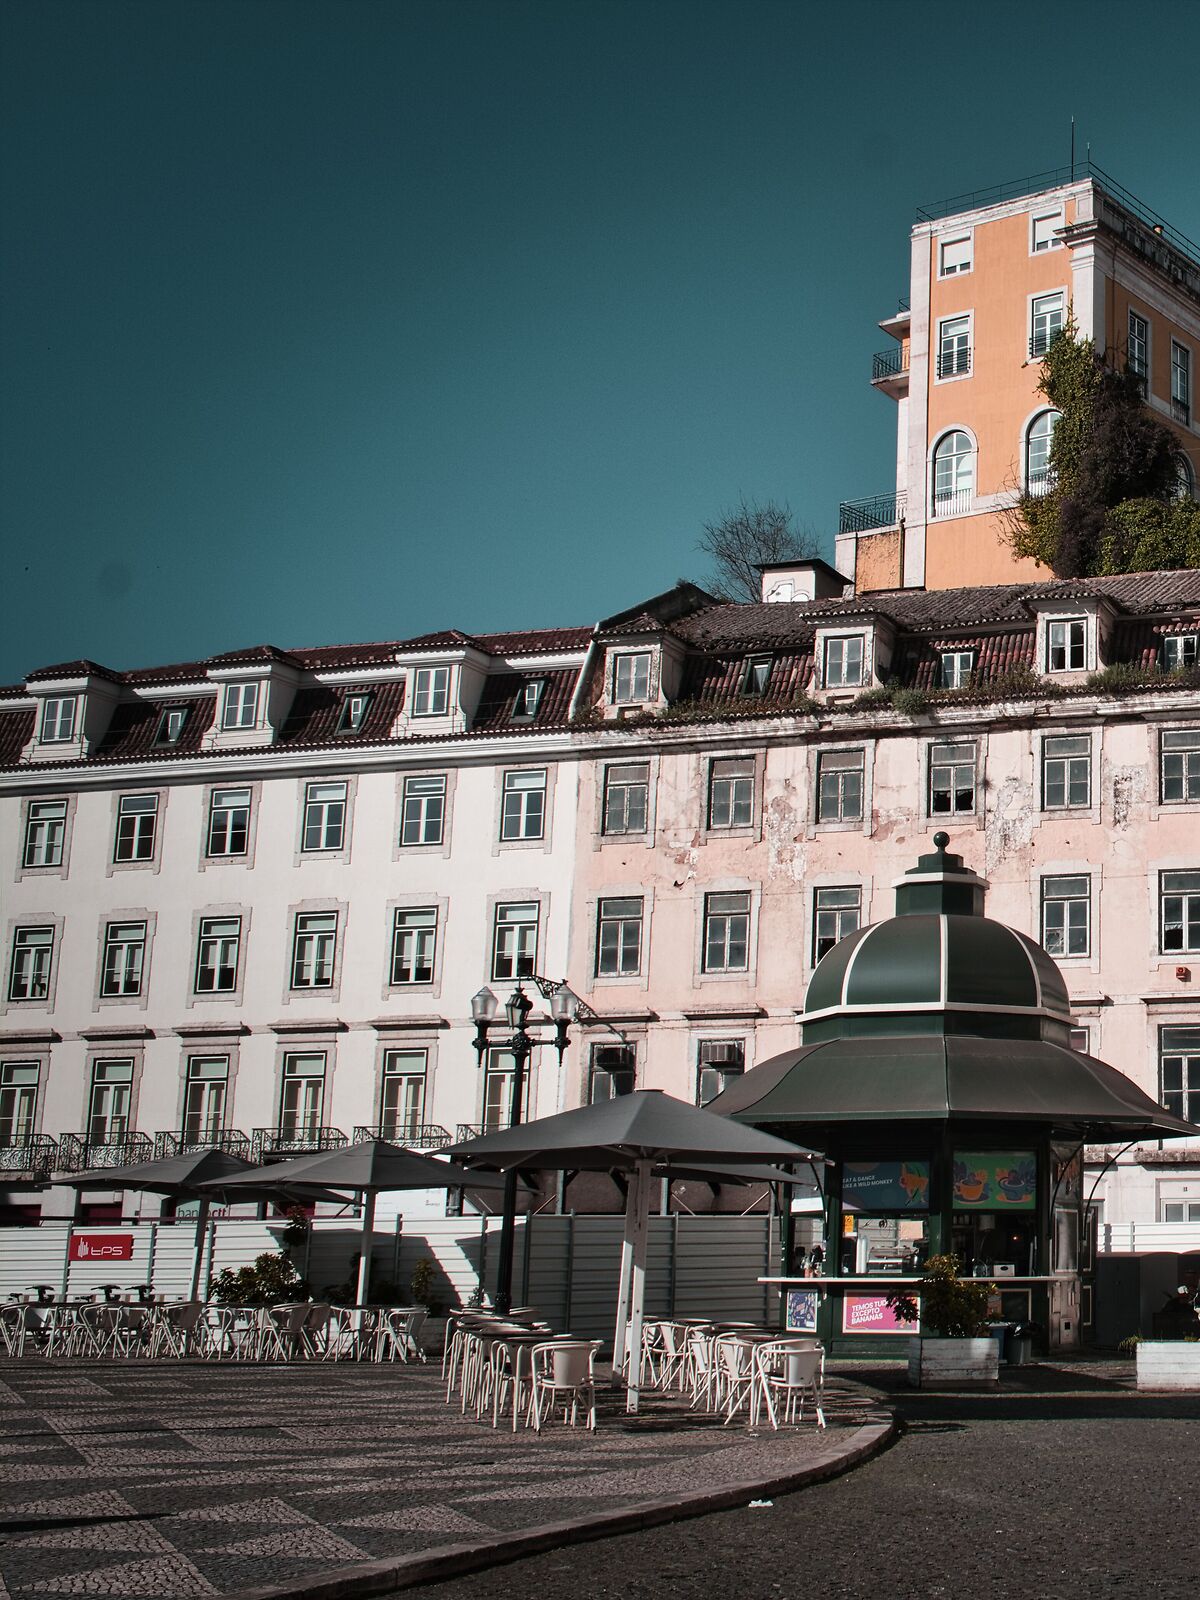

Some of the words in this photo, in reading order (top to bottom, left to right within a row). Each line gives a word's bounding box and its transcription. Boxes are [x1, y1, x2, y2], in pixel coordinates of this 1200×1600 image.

[852, 1302, 873, 1312] TEMOS
[874, 1299, 888, 1307] TUD
[851, 1313, 883, 1324] BANANAS
[852, 1308, 880, 1318] EXCEPTO
